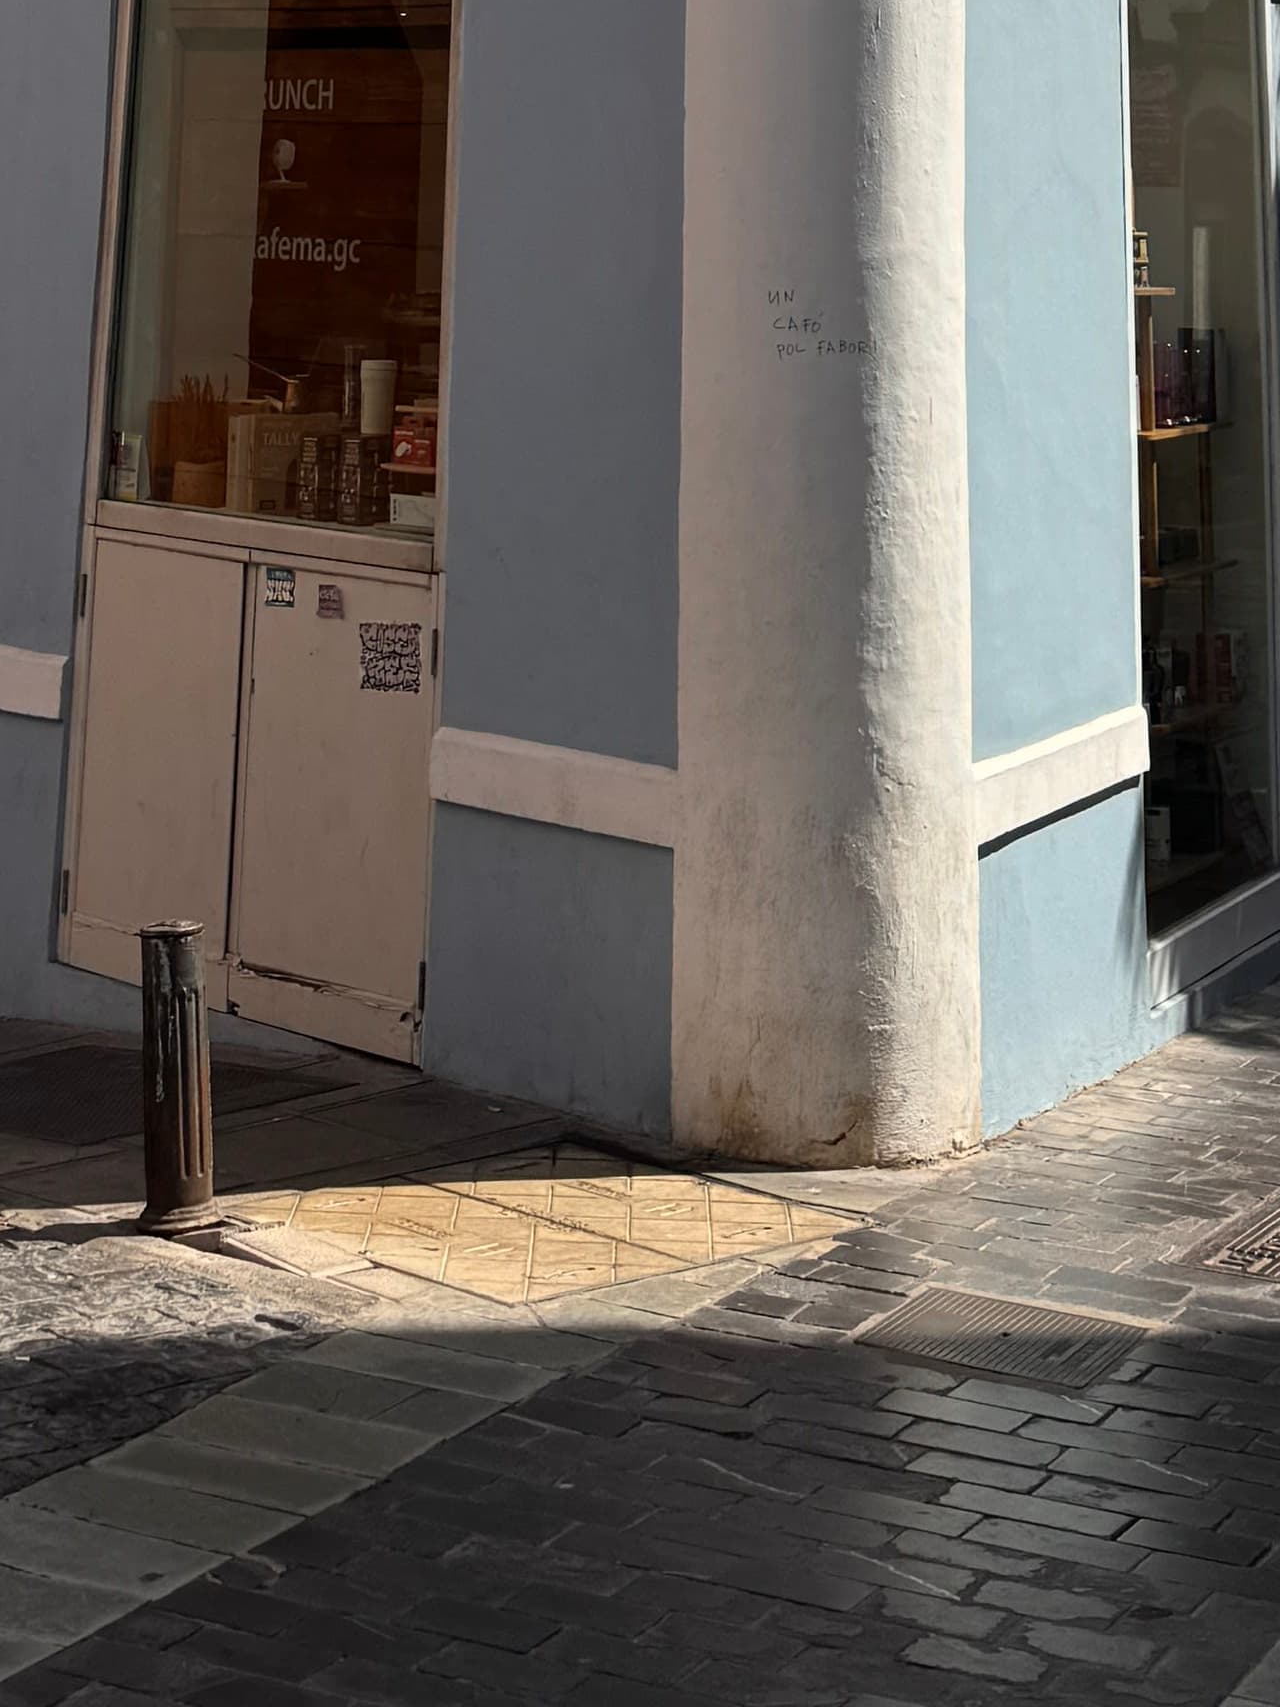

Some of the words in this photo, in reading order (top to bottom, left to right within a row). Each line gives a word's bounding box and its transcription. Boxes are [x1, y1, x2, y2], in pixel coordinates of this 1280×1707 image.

[253, 226, 362, 273] afema.gc
[767, 289, 795, 306] UN
[777, 342, 806, 361] POL
